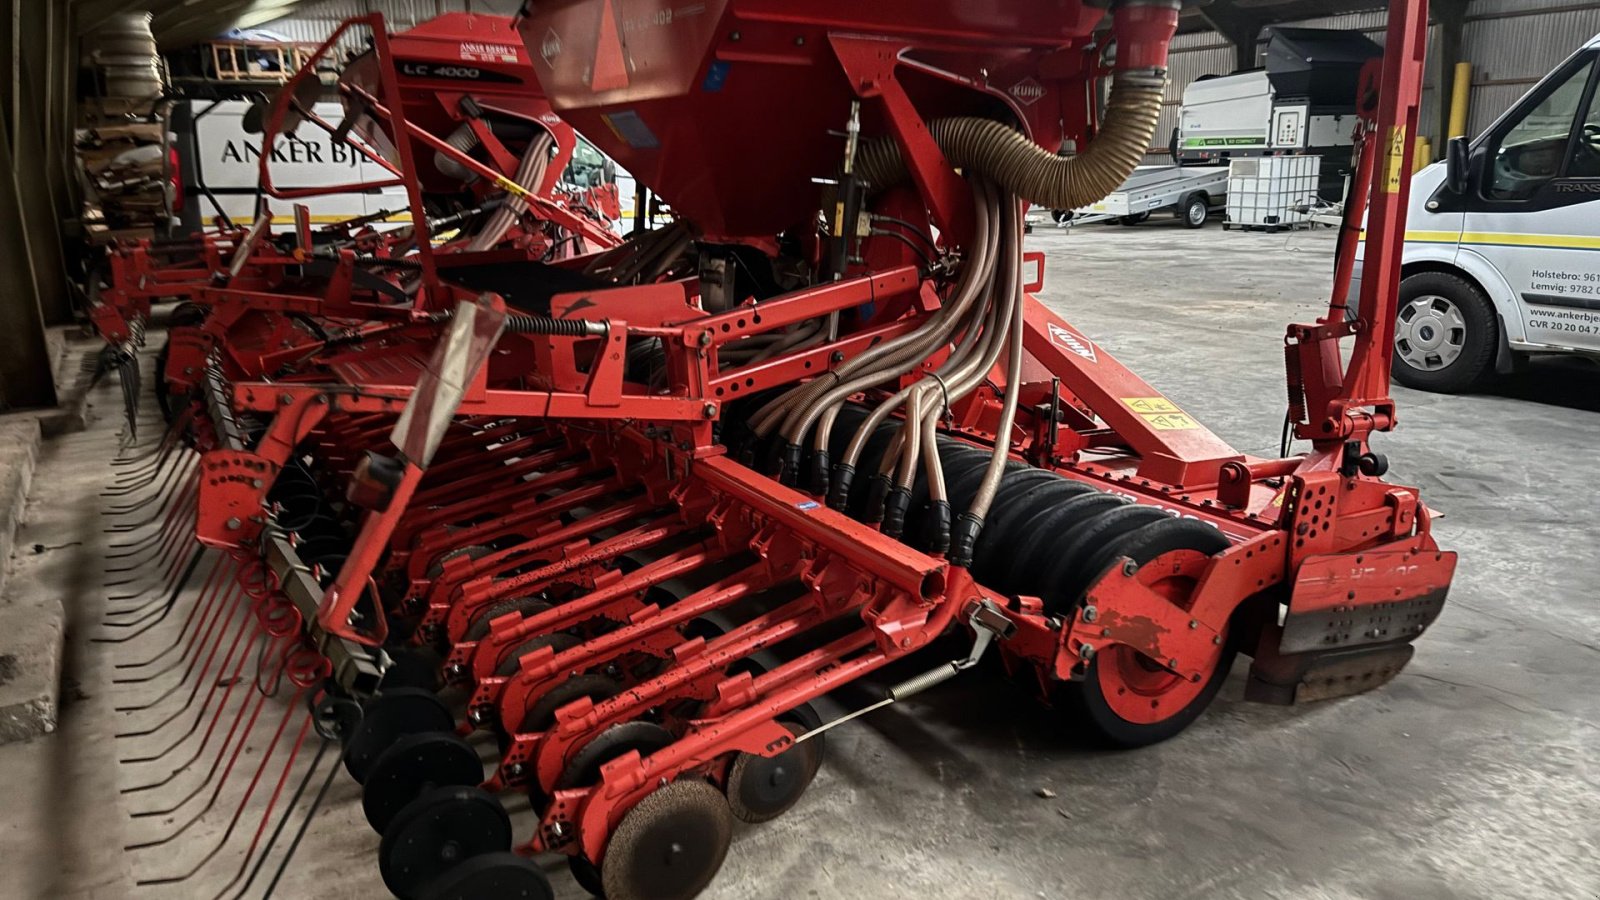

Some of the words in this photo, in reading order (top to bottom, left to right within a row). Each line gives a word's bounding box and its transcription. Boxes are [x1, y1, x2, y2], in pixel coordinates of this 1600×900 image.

[404, 65, 428, 75] LC
[434, 66, 480, 79] 4000
[1013, 86, 1042, 97] KUHN
[221, 139, 324, 163] ANKER
[331, 140, 375, 168] BJE
[1532, 269, 1581, 281] Holstebro:
[1531, 281, 1567, 293] Lemvig:
[1570, 284, 1593, 294] 9782
[1530, 309, 1600, 324] www.ankerbje
[1529, 319, 1548, 328] CVR
[1551, 321, 1562, 330] 20
[1564, 323, 1576, 332] 20
[1579, 325, 1591, 333] 04
[1593, 326, 1600, 335] 7
[1051, 327, 1094, 357] KUHN
